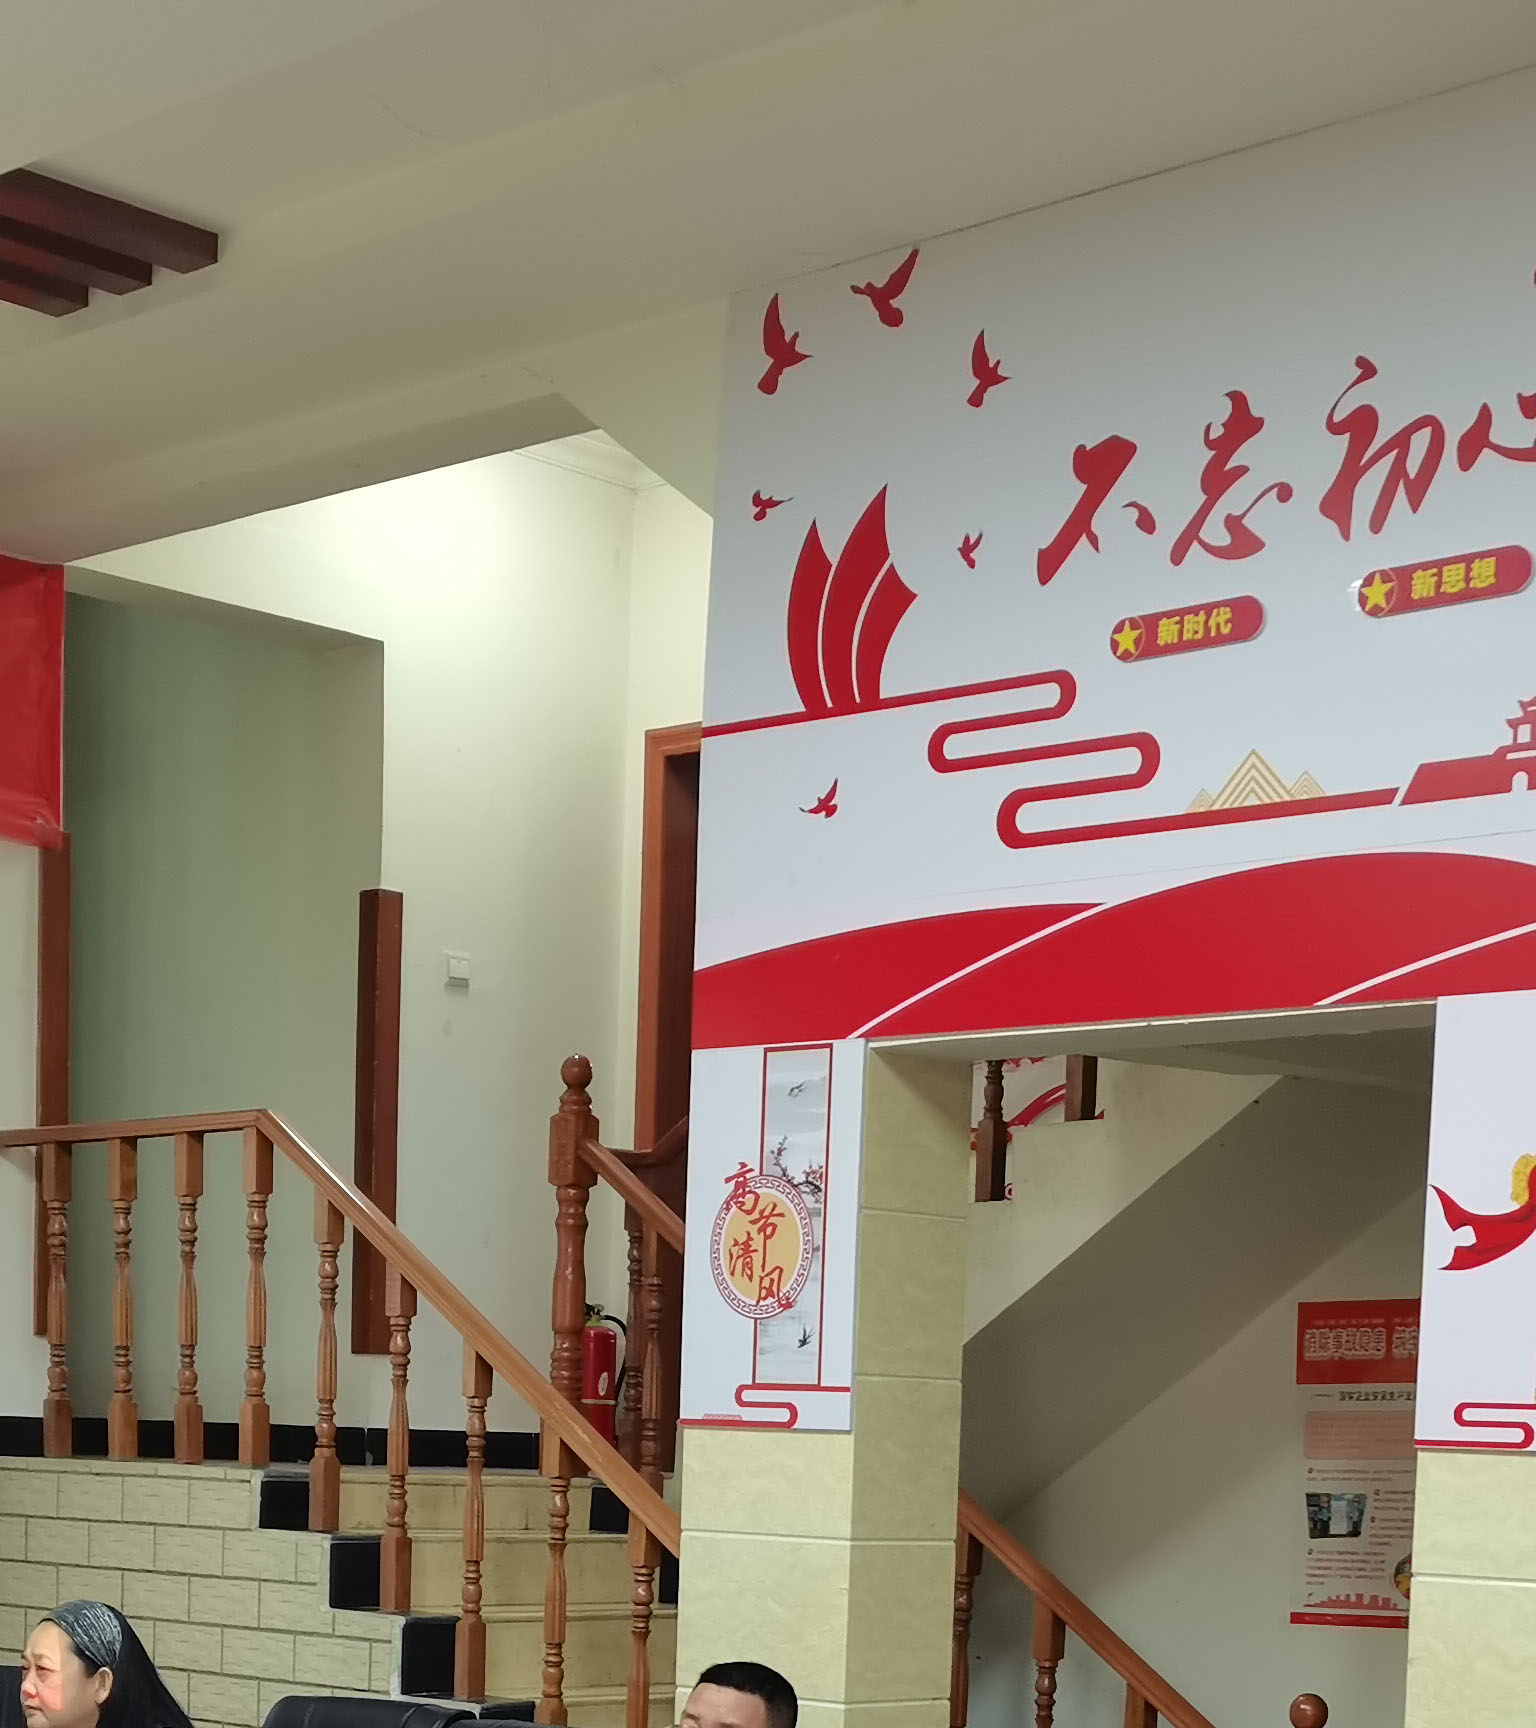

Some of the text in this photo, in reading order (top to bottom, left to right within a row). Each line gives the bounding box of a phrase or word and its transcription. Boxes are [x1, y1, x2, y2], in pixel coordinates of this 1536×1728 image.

[1409, 556, 1497, 600] 新思想
[1156, 606, 1233, 647] 新时代
